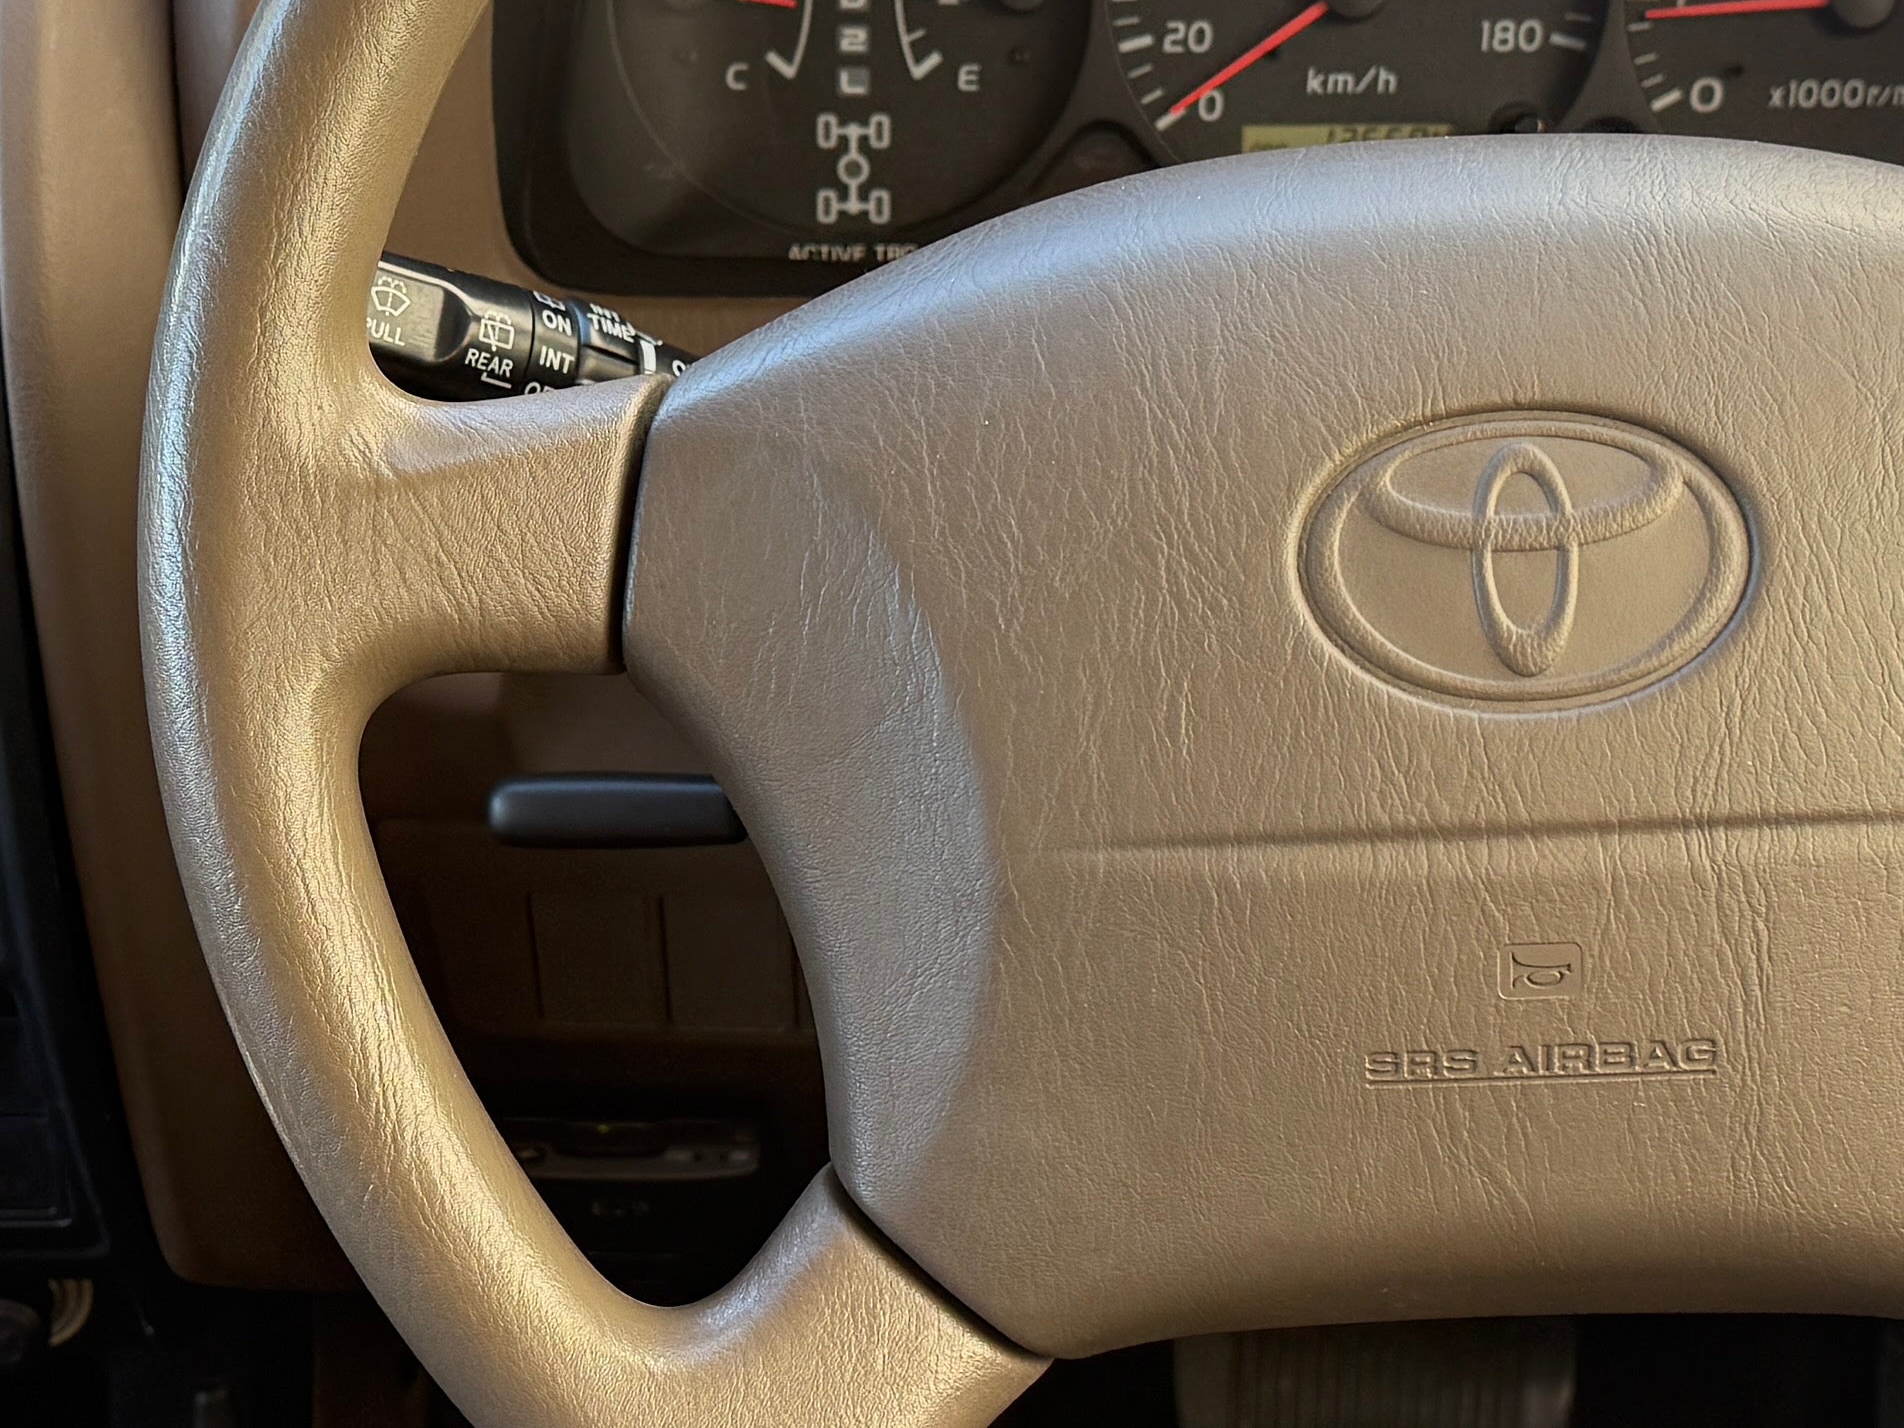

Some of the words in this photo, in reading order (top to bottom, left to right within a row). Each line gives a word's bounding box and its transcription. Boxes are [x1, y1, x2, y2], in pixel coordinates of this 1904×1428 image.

[840, 29, 867, 54] 2
[1161, 21, 1213, 55] 20
[1480, 20, 1543, 54] 180
[726, 65, 749, 91] C
[841, 71, 868, 95] L
[958, 65, 980, 92] E
[1306, 67, 1398, 96] km/h
[1197, 91, 1224, 123] 0
[1690, 81, 1725, 113] 0
[788, 242, 866, 263] ACTIVE
[542, 309, 573, 337] ON
[586, 313, 635, 343] TIME
[465, 346, 514, 379] REAR
[539, 344, 575, 375] INT
[1364, 1049, 1480, 1081] SRS
[1498, 1036, 1719, 1075] AIRBAG
